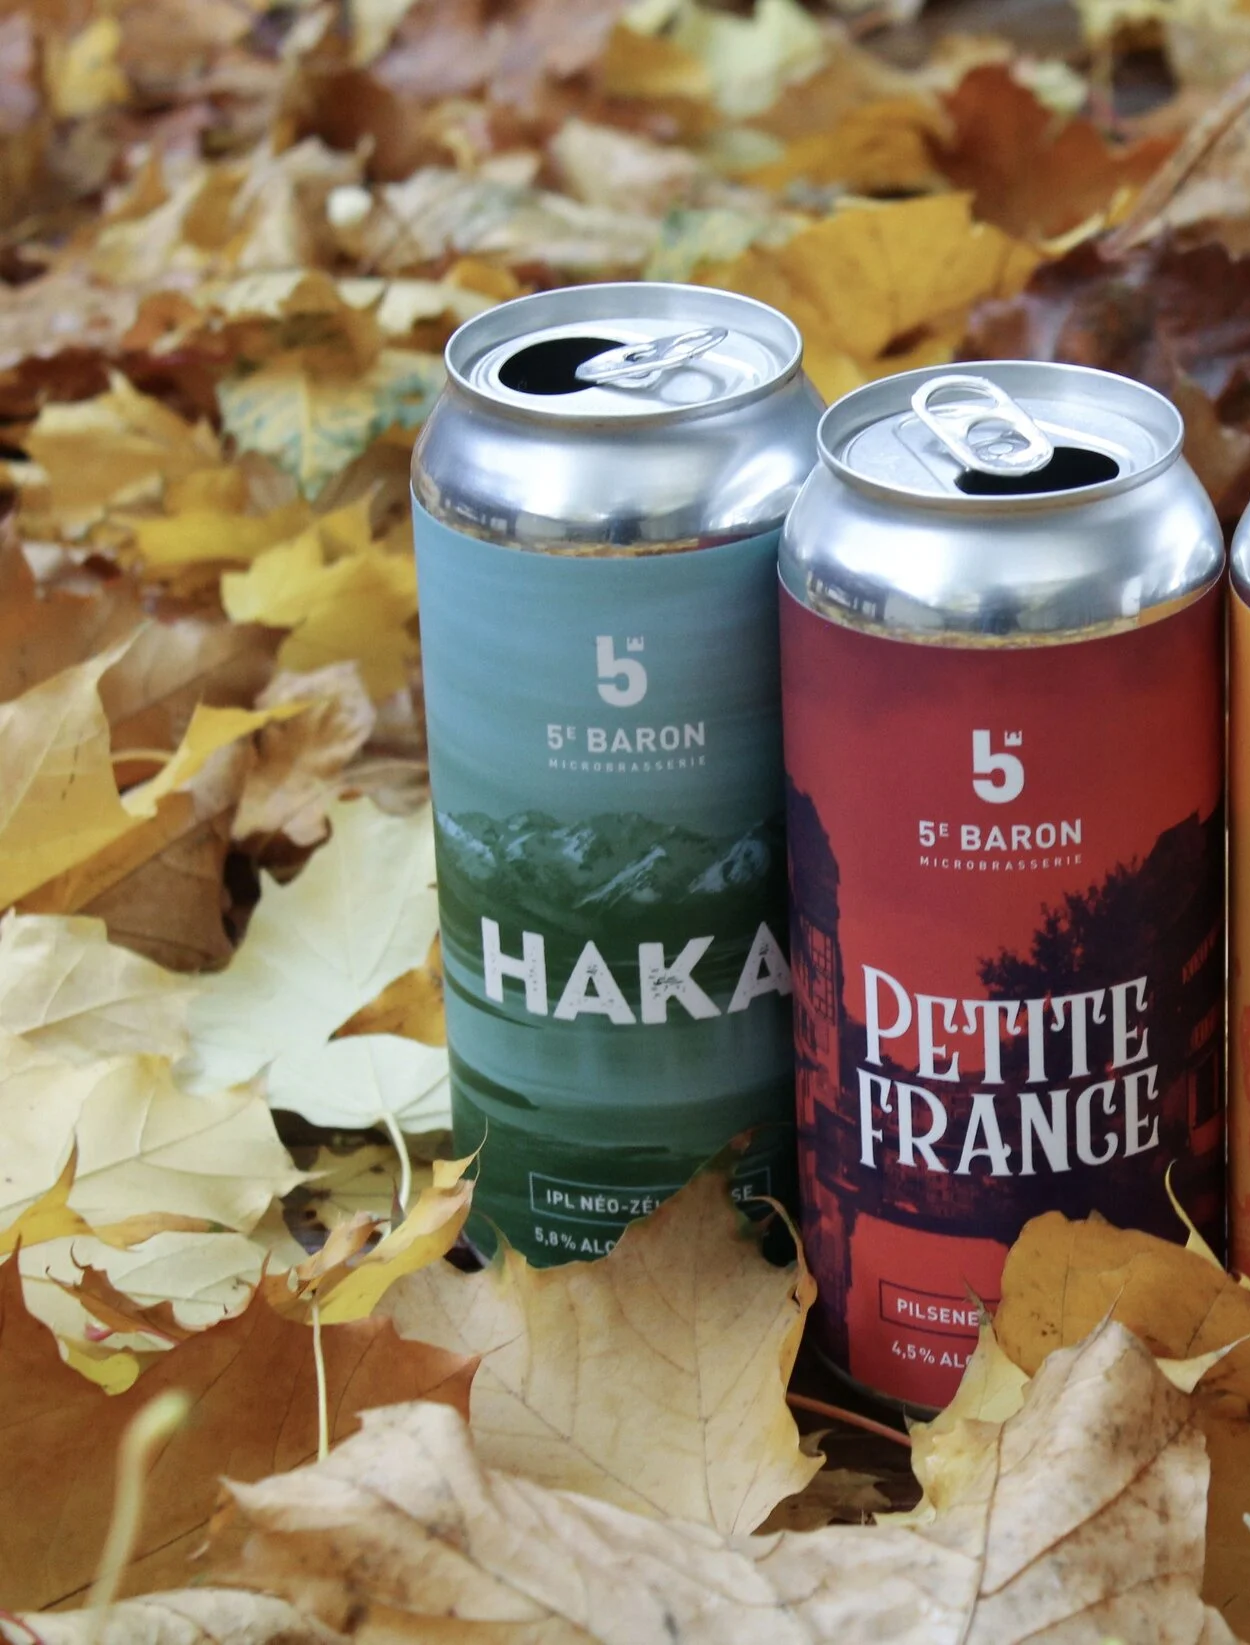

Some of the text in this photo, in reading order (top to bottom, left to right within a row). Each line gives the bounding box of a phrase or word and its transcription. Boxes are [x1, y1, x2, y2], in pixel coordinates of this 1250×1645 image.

[586, 722, 706, 753] BARON
[548, 755, 707, 773] MICROBRASSERIE
[960, 818, 1083, 851] BARON
[919, 854, 1083, 872] MICROBRASSERIE
[481, 916, 793, 1025] HAKA
[861, 963, 1149, 1085] PETITE
[856, 1064, 1160, 1177] FRANCE
[546, 1189, 576, 1209] IPL
